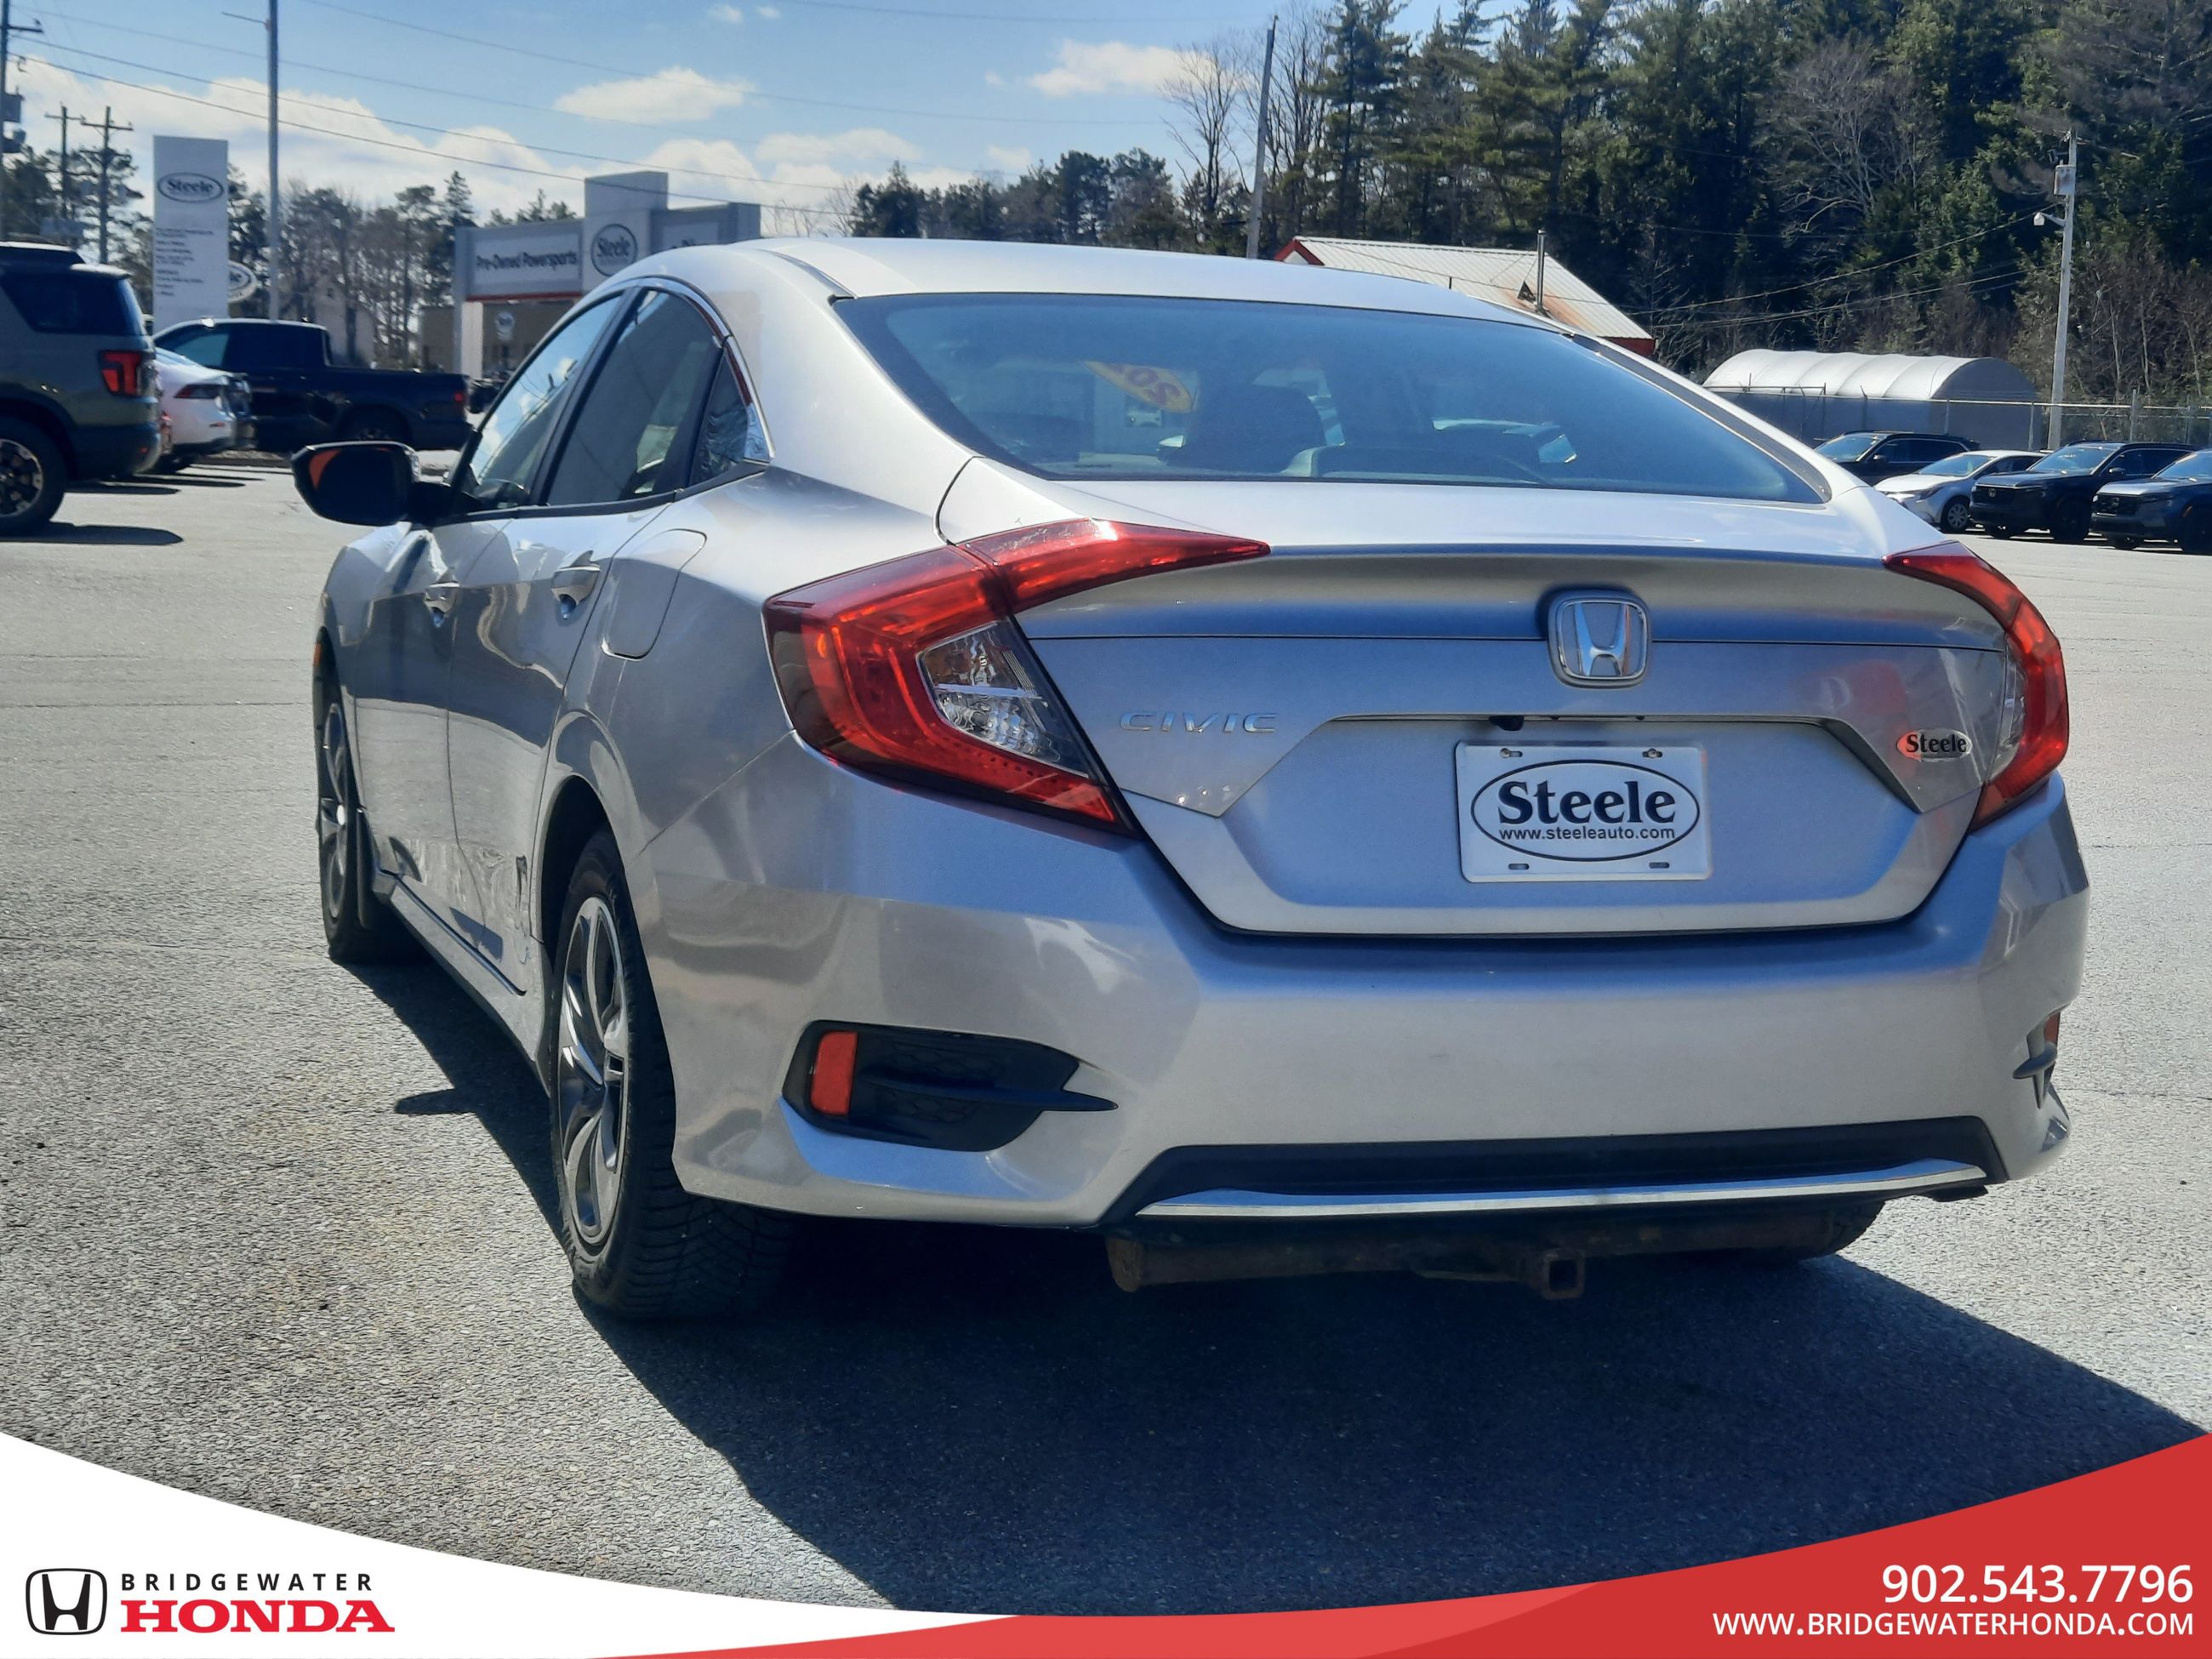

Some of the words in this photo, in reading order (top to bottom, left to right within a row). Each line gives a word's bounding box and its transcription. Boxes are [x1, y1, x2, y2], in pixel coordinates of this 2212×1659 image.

[167, 180, 213, 193] Steele
[1120, 711, 1278, 733] CIVIC
[1906, 733, 1967, 753] Steele
[1497, 779, 1676, 824] Steele
[1499, 826, 1675, 840] www.steeleauto.com
